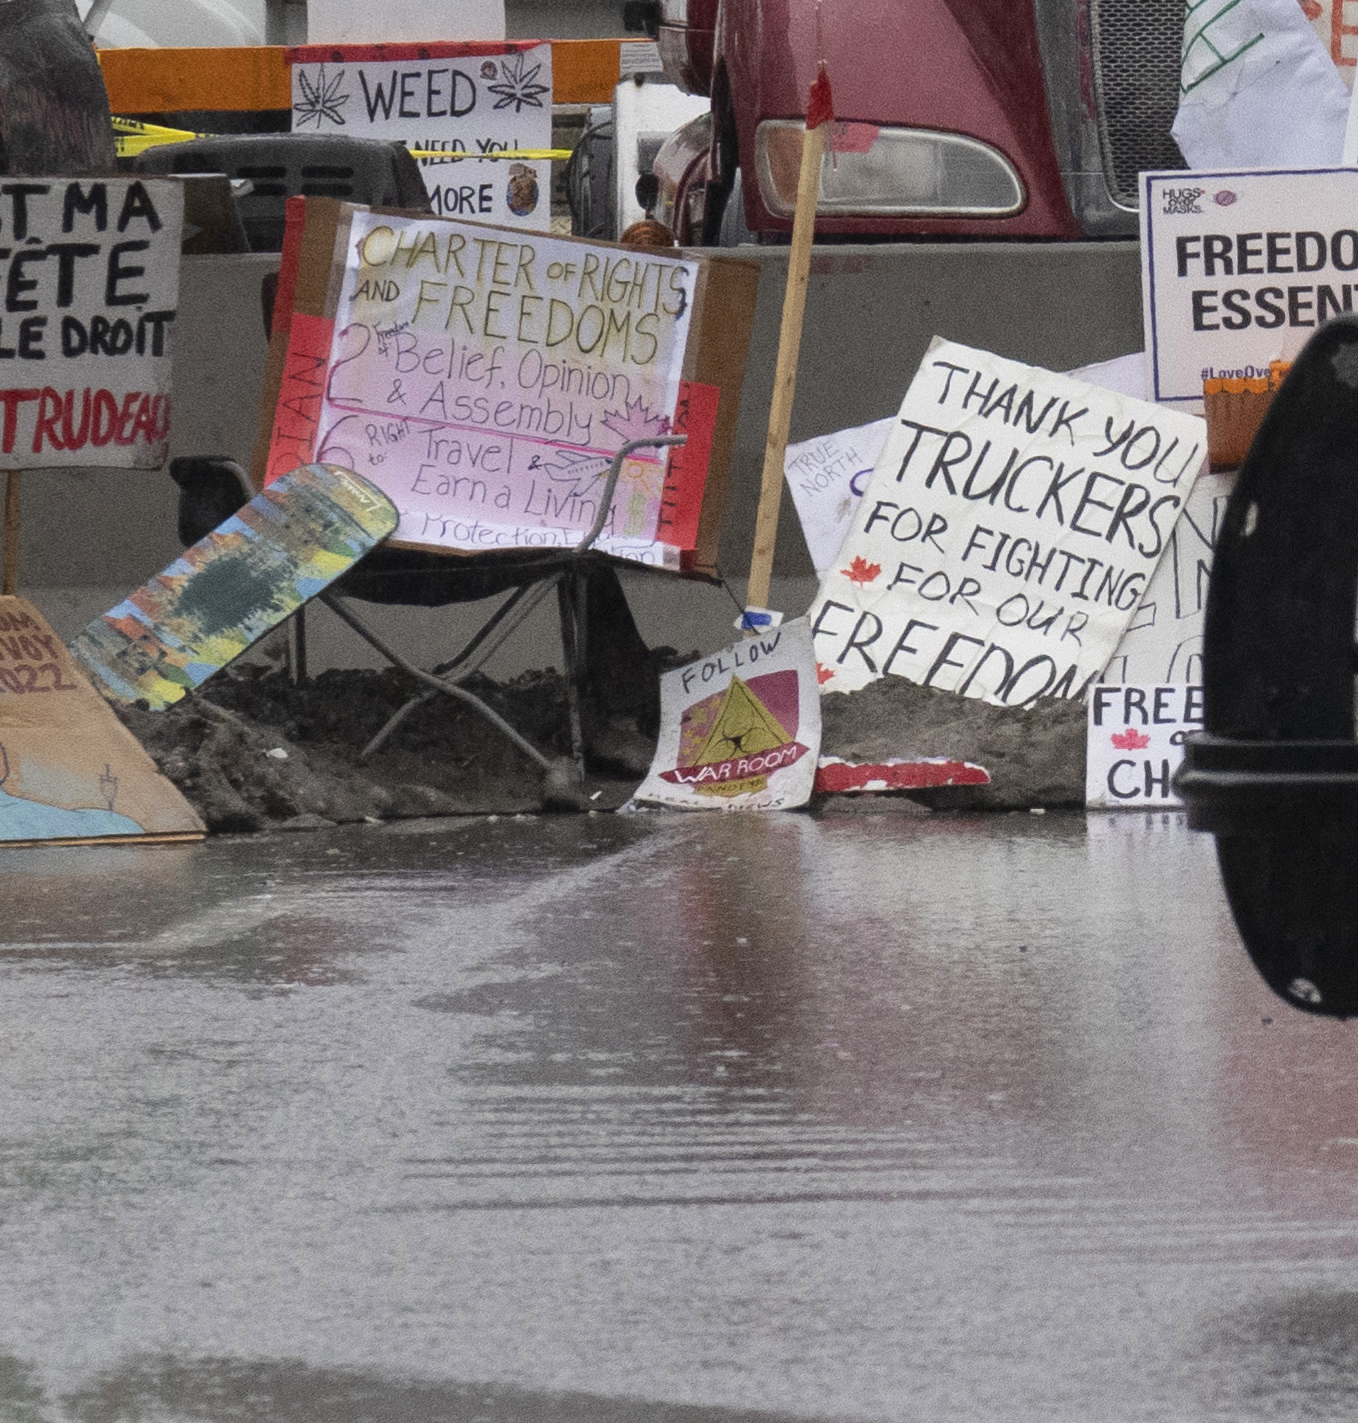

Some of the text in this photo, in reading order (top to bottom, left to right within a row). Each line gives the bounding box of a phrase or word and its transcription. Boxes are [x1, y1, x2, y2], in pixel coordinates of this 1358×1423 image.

[358, 68, 476, 123] WEED
[414, 138, 466, 167] NEED
[62, 181, 163, 233] MA
[429, 183, 494, 216] MORE
[1162, 187, 1201, 200] HUGS
[0, 236, 150, 312] ÊTE
[360, 225, 536, 290] CHARTER
[578, 252, 691, 318] RIGHTS
[61, 310, 176, 359] DROIT
[352, 279, 661, 365] AND FREEDOMS
[517, 348, 632, 402] Opinion
[1200, 364, 1272, 380] #LoveOve
[0, 386, 172, 454] TRUDEAU
[365, 415, 412, 449] RIGHT
[386, 378, 594, 446] & Assembly
[933, 361, 1199, 488] THANK YOU
[417, 425, 545, 474] Travel &
[788, 439, 839, 476] TRUE
[800, 446, 863, 497] NORTH
[410, 463, 488, 504] Earn
[493, 485, 512, 511] a
[895, 418, 1182, 558] TRUCKERS
[863, 501, 1146, 611] FOR FIGHTING
[886, 561, 1090, 647] FOR OUR
[0, 634, 59, 660] VOY
[681, 631, 782, 694] FOLLOW
[0, 663, 77, 694] 022
[674, 745, 798, 784] WAR ROOM
[1107, 759, 1170, 799] CH
